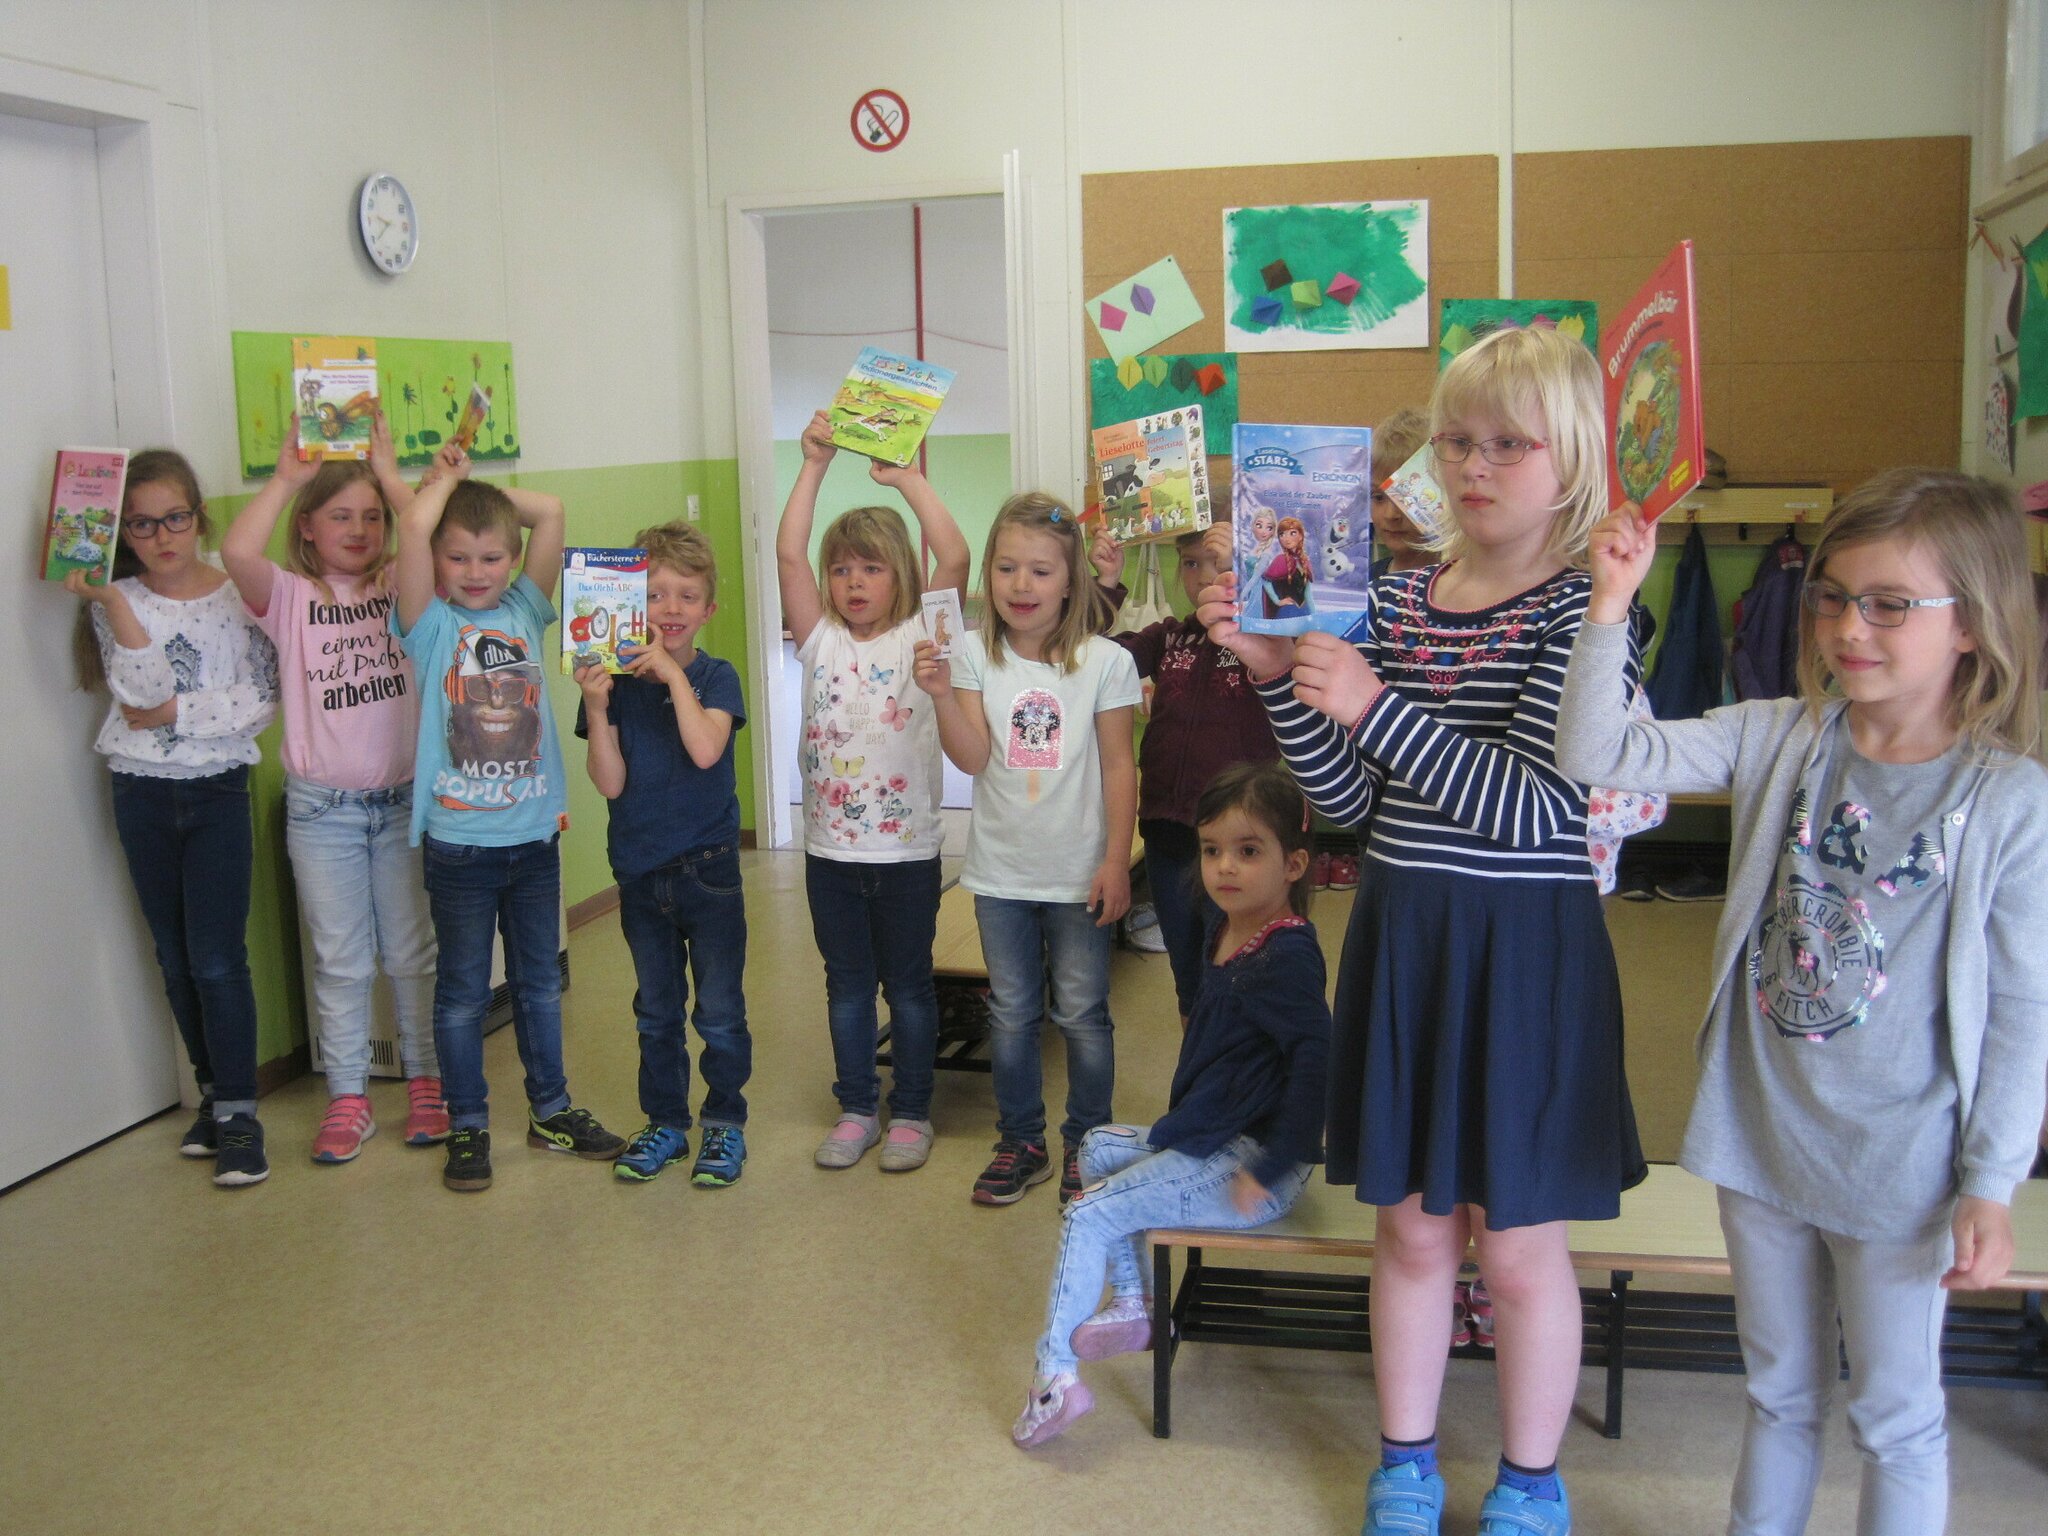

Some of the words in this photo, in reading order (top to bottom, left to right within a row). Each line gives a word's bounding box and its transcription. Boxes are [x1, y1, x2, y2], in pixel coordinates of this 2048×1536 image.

[860, 363, 938, 391] Indianergeschichten
[1100, 440, 1145, 458] Lieselotte
[1253, 455, 1289, 467] STARS
[1278, 490, 1292, 498] und
[1306, 491, 1332, 500] Zauber
[586, 553, 634, 563] Büchersterne
[578, 582, 592, 592] Das
[323, 673, 407, 711] arbeiten
[462, 760, 529, 780] MOST
[1775, 991, 1834, 1021] FITCH
